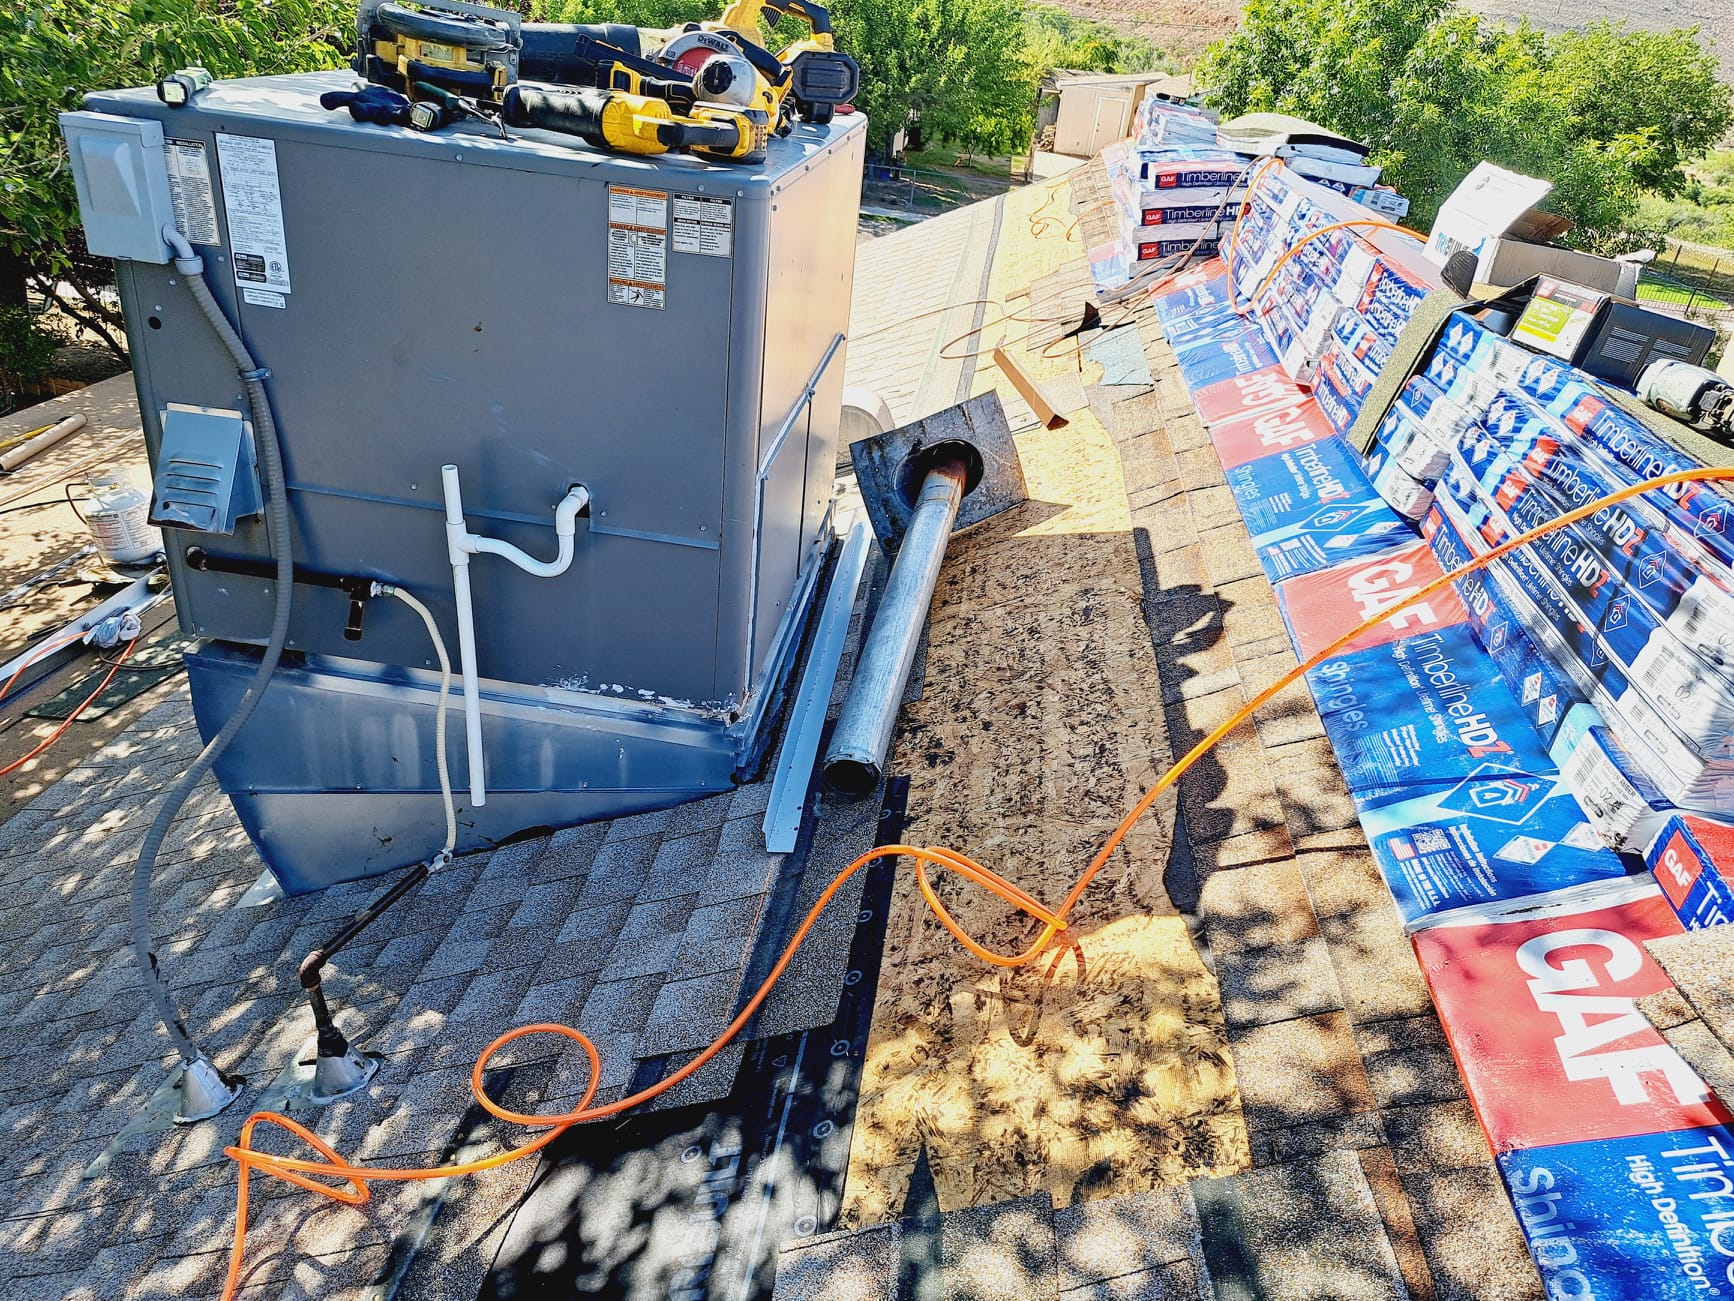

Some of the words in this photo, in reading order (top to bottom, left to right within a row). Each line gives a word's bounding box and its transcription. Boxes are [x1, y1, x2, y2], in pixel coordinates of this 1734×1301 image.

[1160, 175, 1176, 183] GAF
[1145, 213, 1161, 221] GAF
[1253, 406, 1316, 446] GAF
[1347, 562, 1438, 630] GAF
[1320, 660, 1368, 732] Shingles
[1663, 848, 1693, 888] GAF
[1515, 928, 1712, 1106] GAF
[1624, 1154, 1667, 1204] High
